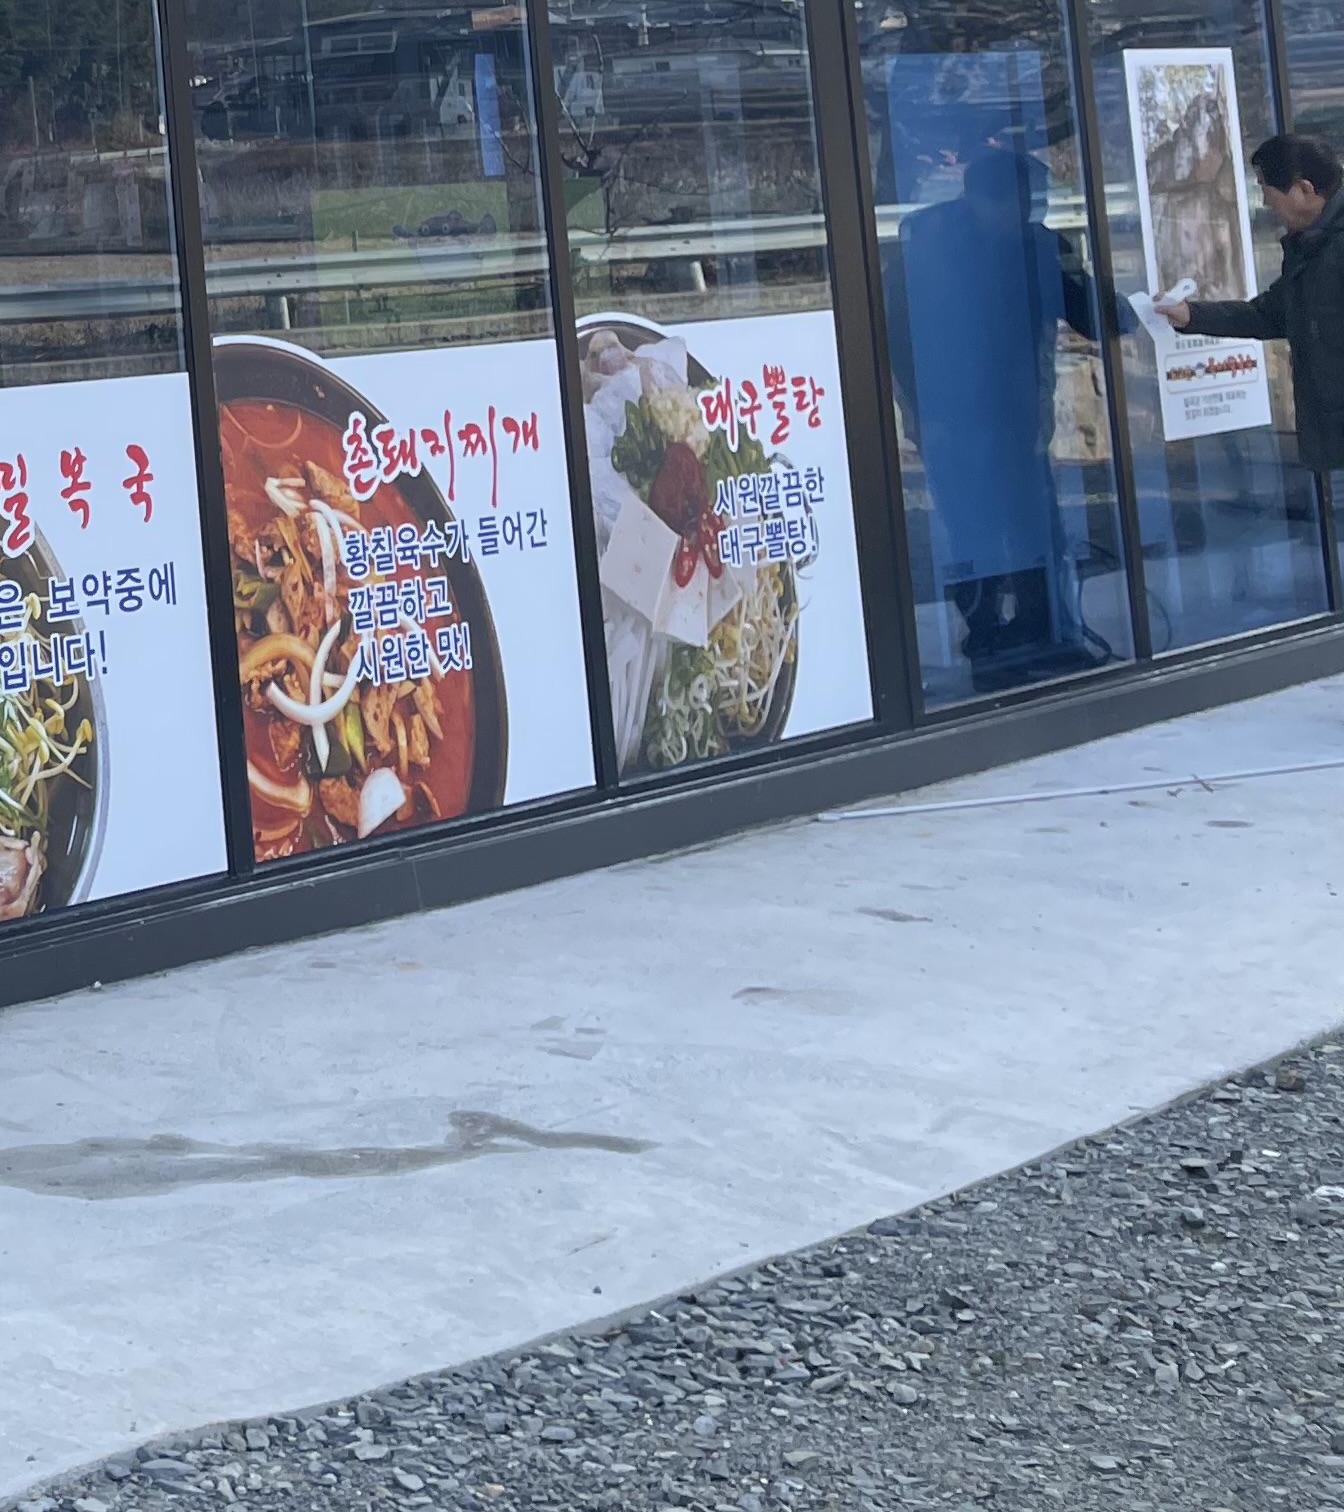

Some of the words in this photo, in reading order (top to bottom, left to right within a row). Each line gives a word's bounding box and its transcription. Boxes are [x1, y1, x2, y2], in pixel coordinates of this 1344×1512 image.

[701, 364, 825, 445] 대구뽈탕
[346, 405, 539, 508] 촌돼지찌개
[716, 466, 825, 517] 시원깔끔한
[345, 519, 470, 577] 황칠육수가
[478, 508, 548, 557] 들어간
[719, 516, 817, 565] 대구뽈탕!
[48, 561, 177, 620] 보약중에
[349, 578, 452, 631] 깔끔하고
[356, 631, 430, 684] 시원한
[438, 624, 473, 672] 맛!
